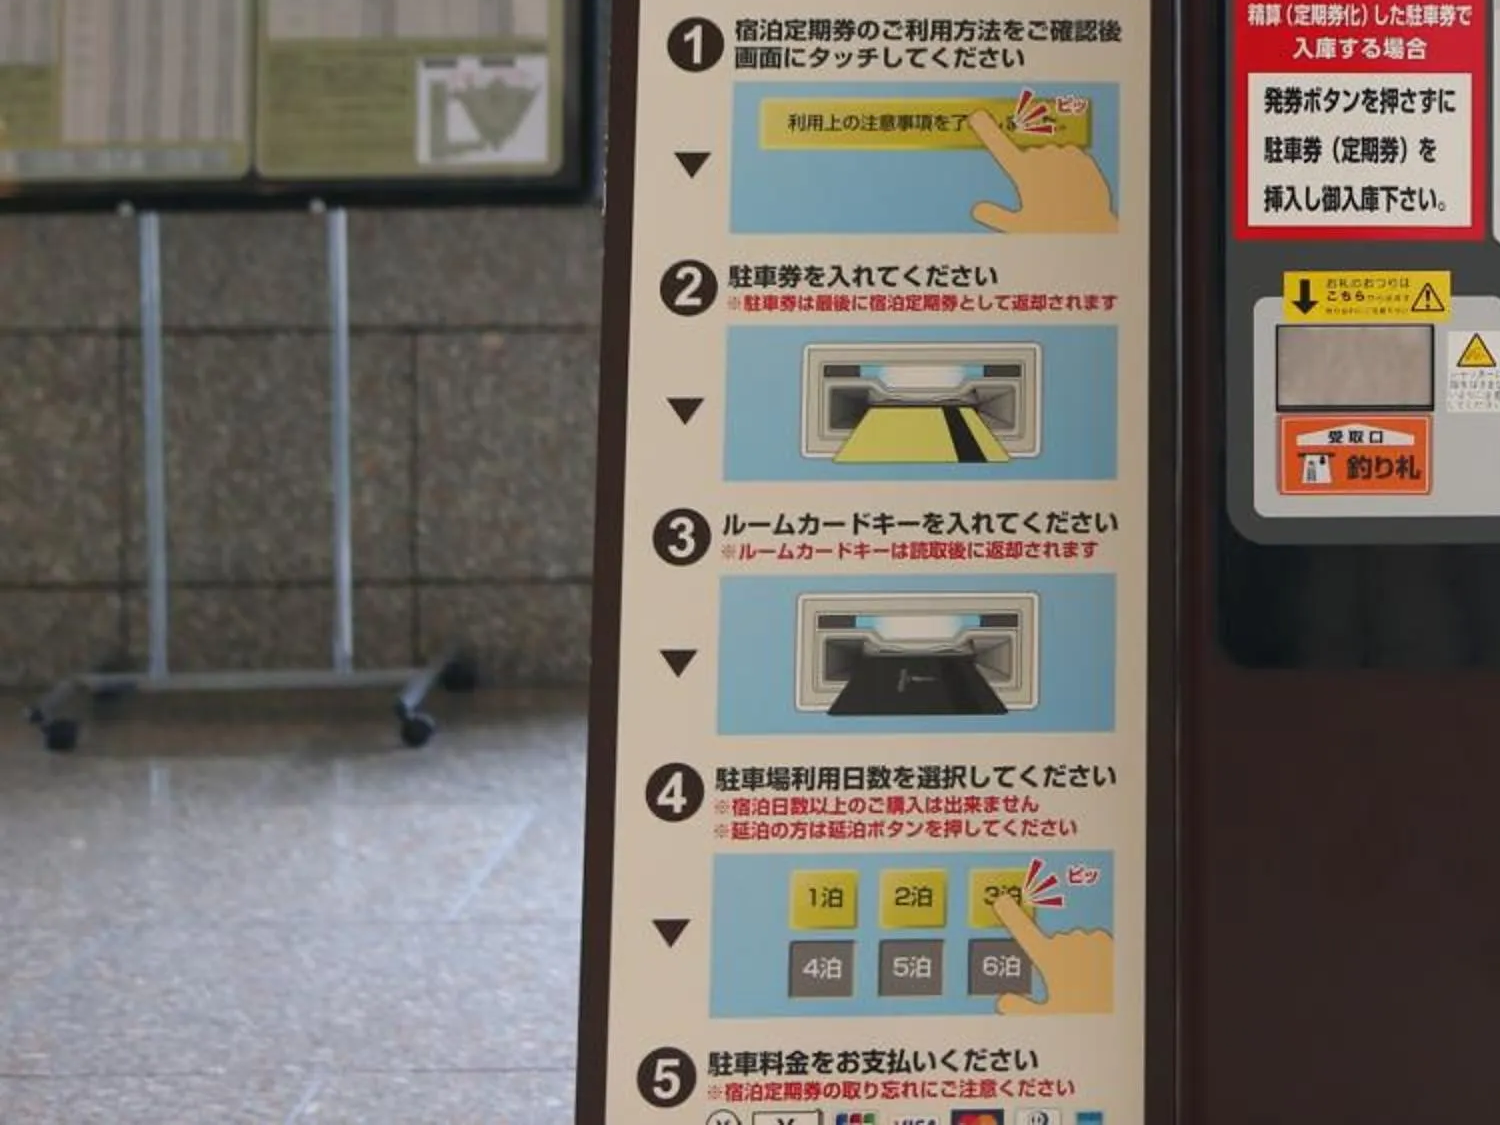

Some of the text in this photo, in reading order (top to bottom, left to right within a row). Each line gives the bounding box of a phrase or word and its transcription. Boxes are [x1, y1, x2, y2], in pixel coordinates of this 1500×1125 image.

[735, 18, 1122, 43] 宿泊定期券のご利用方法をご確認後
[682, 26, 706, 65] 1
[734, 45, 1025, 70] 画面にタッチしてください
[1293, 38, 1427, 60] 入庫する場合
[1264, 87, 1456, 114] 発券ボタンを押さずに
[1264, 136, 1436, 163] 駐車券（定期券）を
[1264, 185, 1446, 212] 挿入し御入庫下さい。
[674, 268, 703, 306] 2
[728, 264, 997, 288] 駐車券を入れてください
[1328, 430, 1384, 444] 受取口
[1346, 454, 1422, 480] 釣り札
[722, 511, 1118, 536] ルームカードキーを入れてください
[667, 517, 696, 557] 3
[715, 765, 1116, 790] 駐車場利用日数を選択してください
[657, 772, 685, 813] 4
[808, 886, 844, 908] 1泊
[895, 886, 934, 908] 2泊
[803, 957, 842, 980] 4泊
[893, 956, 932, 979] 5泊
[983, 955, 1021, 978] 6泊
[708, 1048, 1038, 1076] 駐車料金をお支払いください
[654, 1058, 681, 1097] 5
